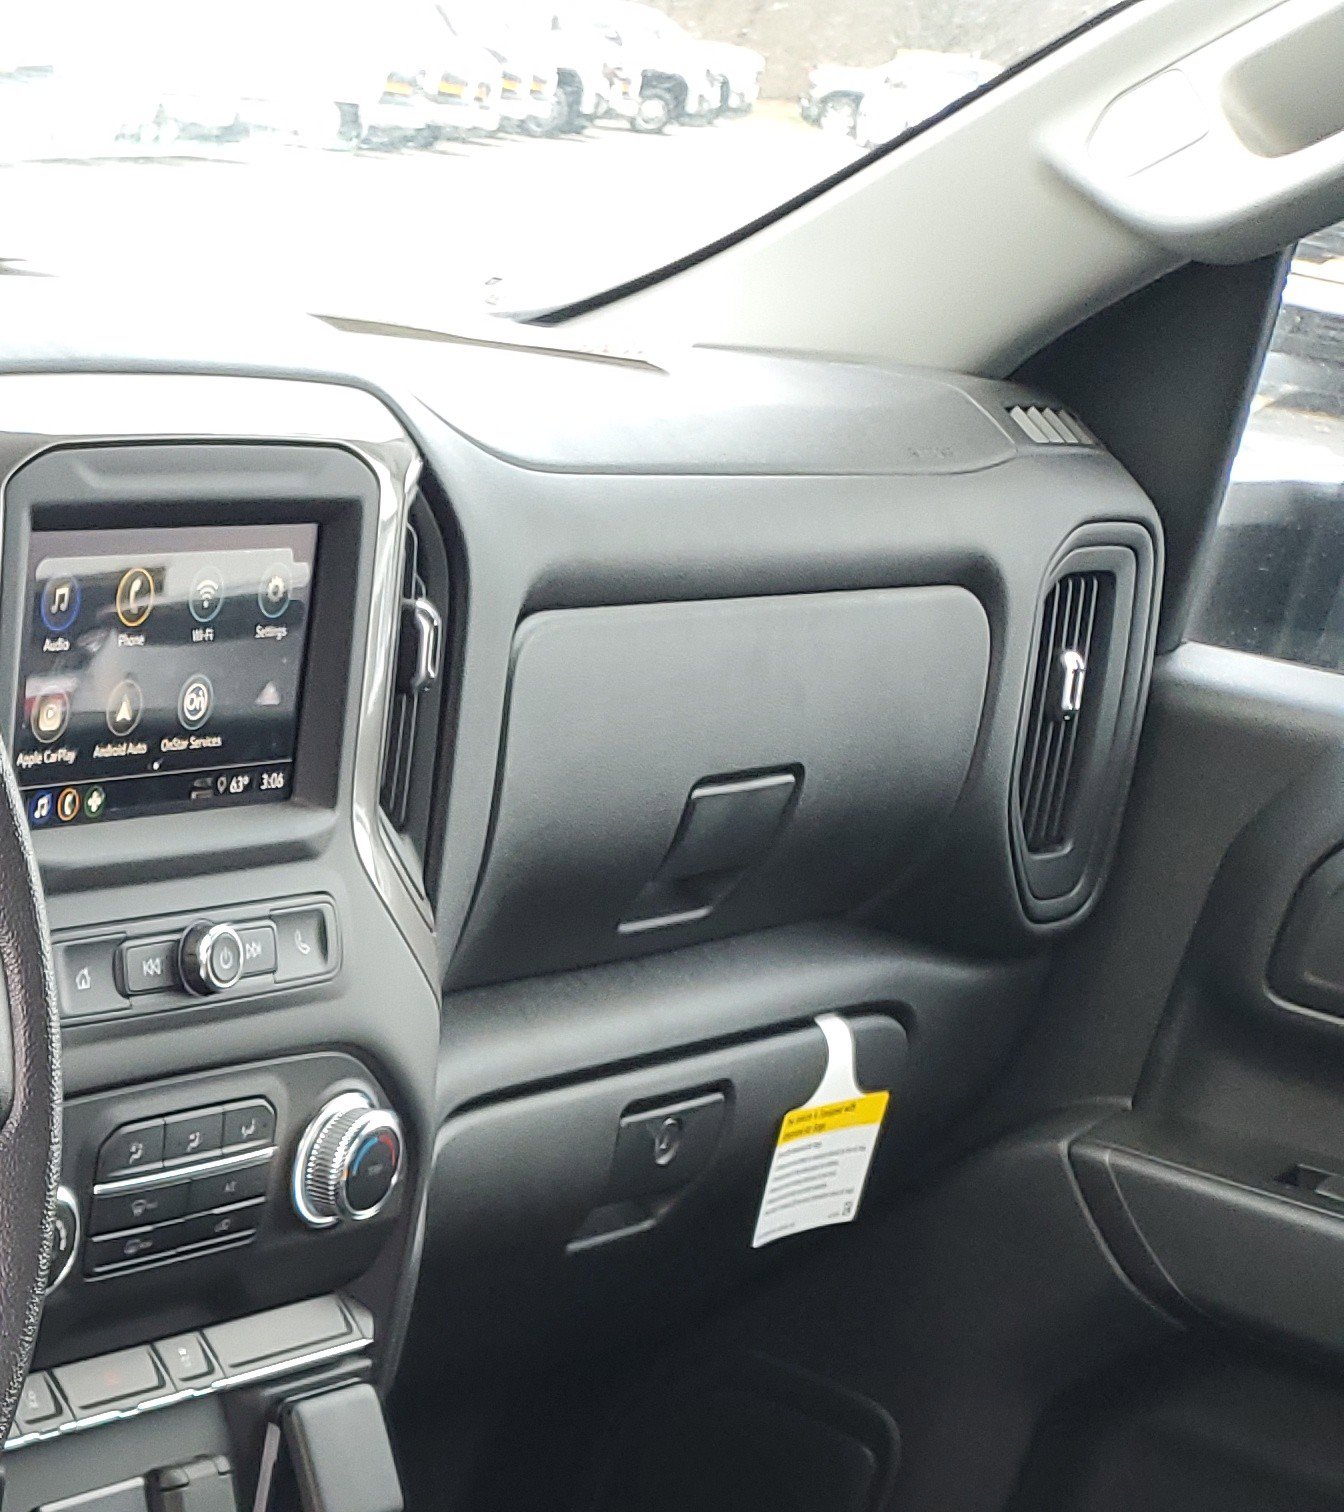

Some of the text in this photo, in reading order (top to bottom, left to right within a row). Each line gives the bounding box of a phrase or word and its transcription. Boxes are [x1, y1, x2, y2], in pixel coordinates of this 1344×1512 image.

[118, 633, 145, 646] Phone
[192, 628, 214, 642] Wi-Fi
[255, 624, 288, 641] Settings
[43, 637, 70, 652] Audio
[92, 742, 148, 759] Android Auto
[160, 735, 222, 752] OnStar Services
[16, 749, 76, 767] Apple CarPlay
[260, 772, 285, 791] 3:06
